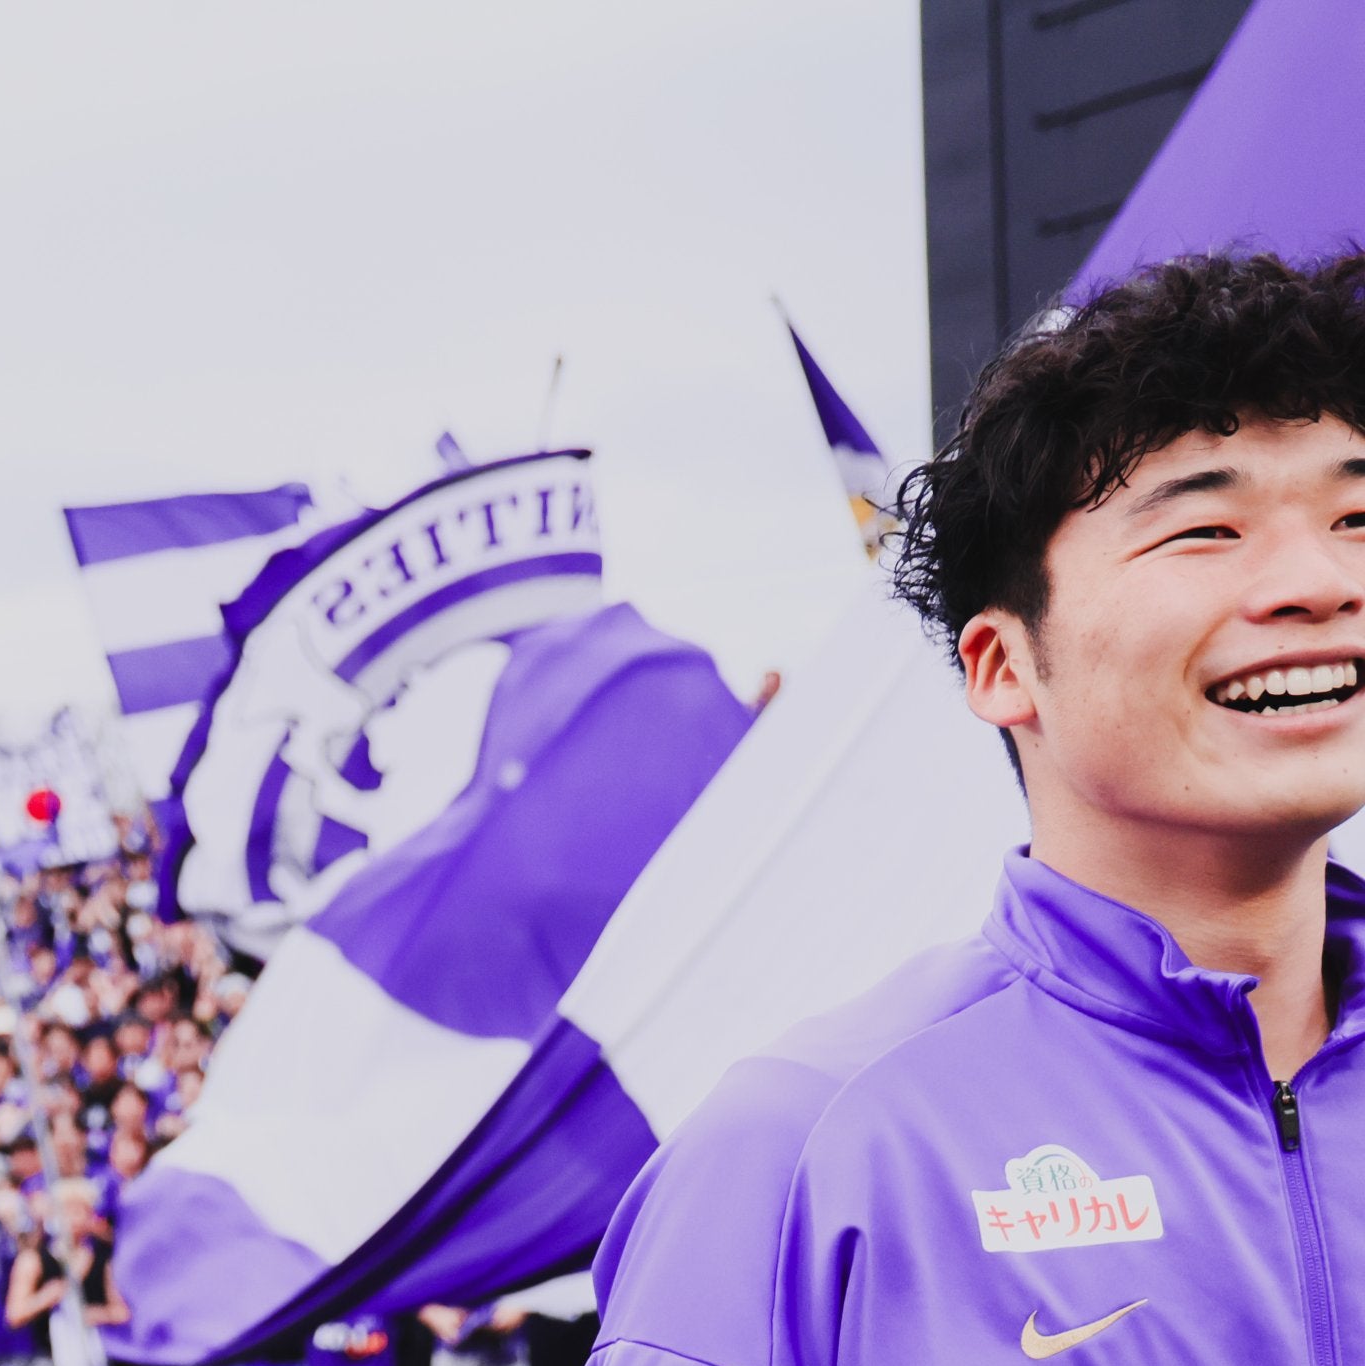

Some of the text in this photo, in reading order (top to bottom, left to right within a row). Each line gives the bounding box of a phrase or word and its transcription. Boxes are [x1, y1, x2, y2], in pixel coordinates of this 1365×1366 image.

[986, 1193, 1149, 1242] キャリカレ
